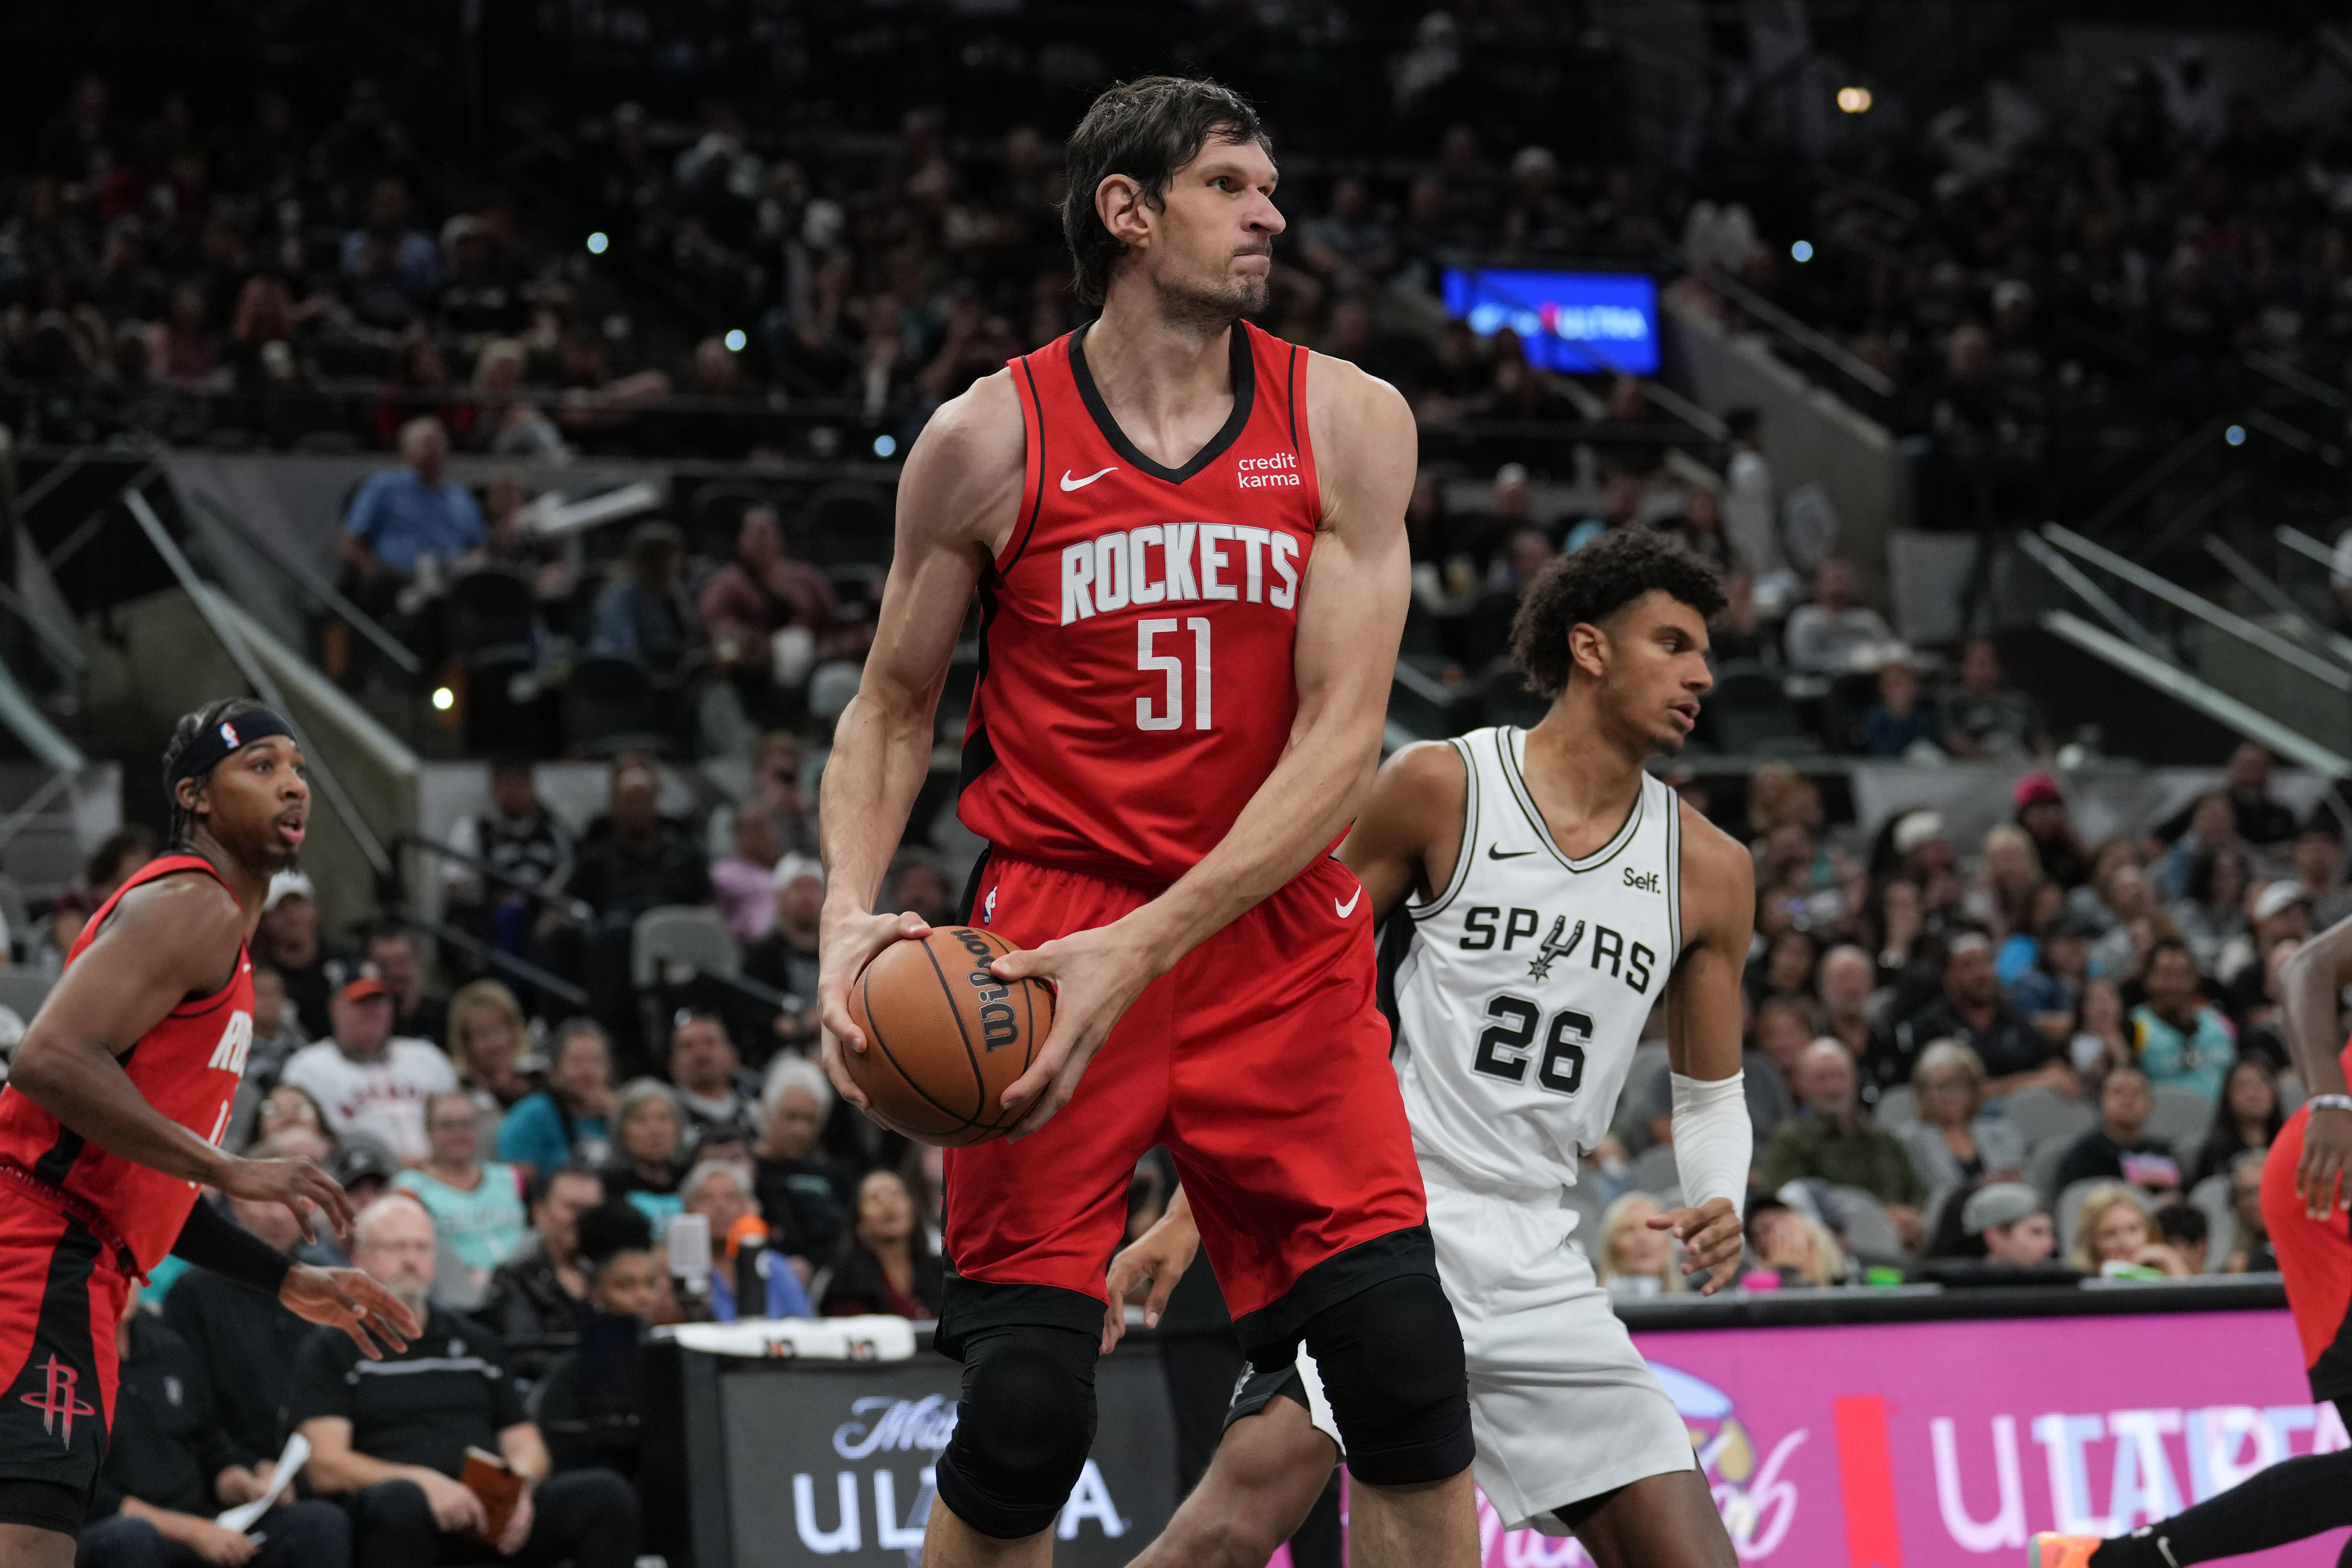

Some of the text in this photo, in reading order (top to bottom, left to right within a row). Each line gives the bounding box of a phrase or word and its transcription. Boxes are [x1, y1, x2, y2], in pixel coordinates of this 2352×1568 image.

[1237, 472, 1300, 488] karma
[1238, 453, 1296, 471] credit
[1060, 522, 1299, 627] ROCKETS
[1136, 617, 1211, 731] 51
[1623, 867, 1661, 894] Self.
[1459, 907, 1655, 995] SPURS
[1469, 991, 1597, 1097] 26
